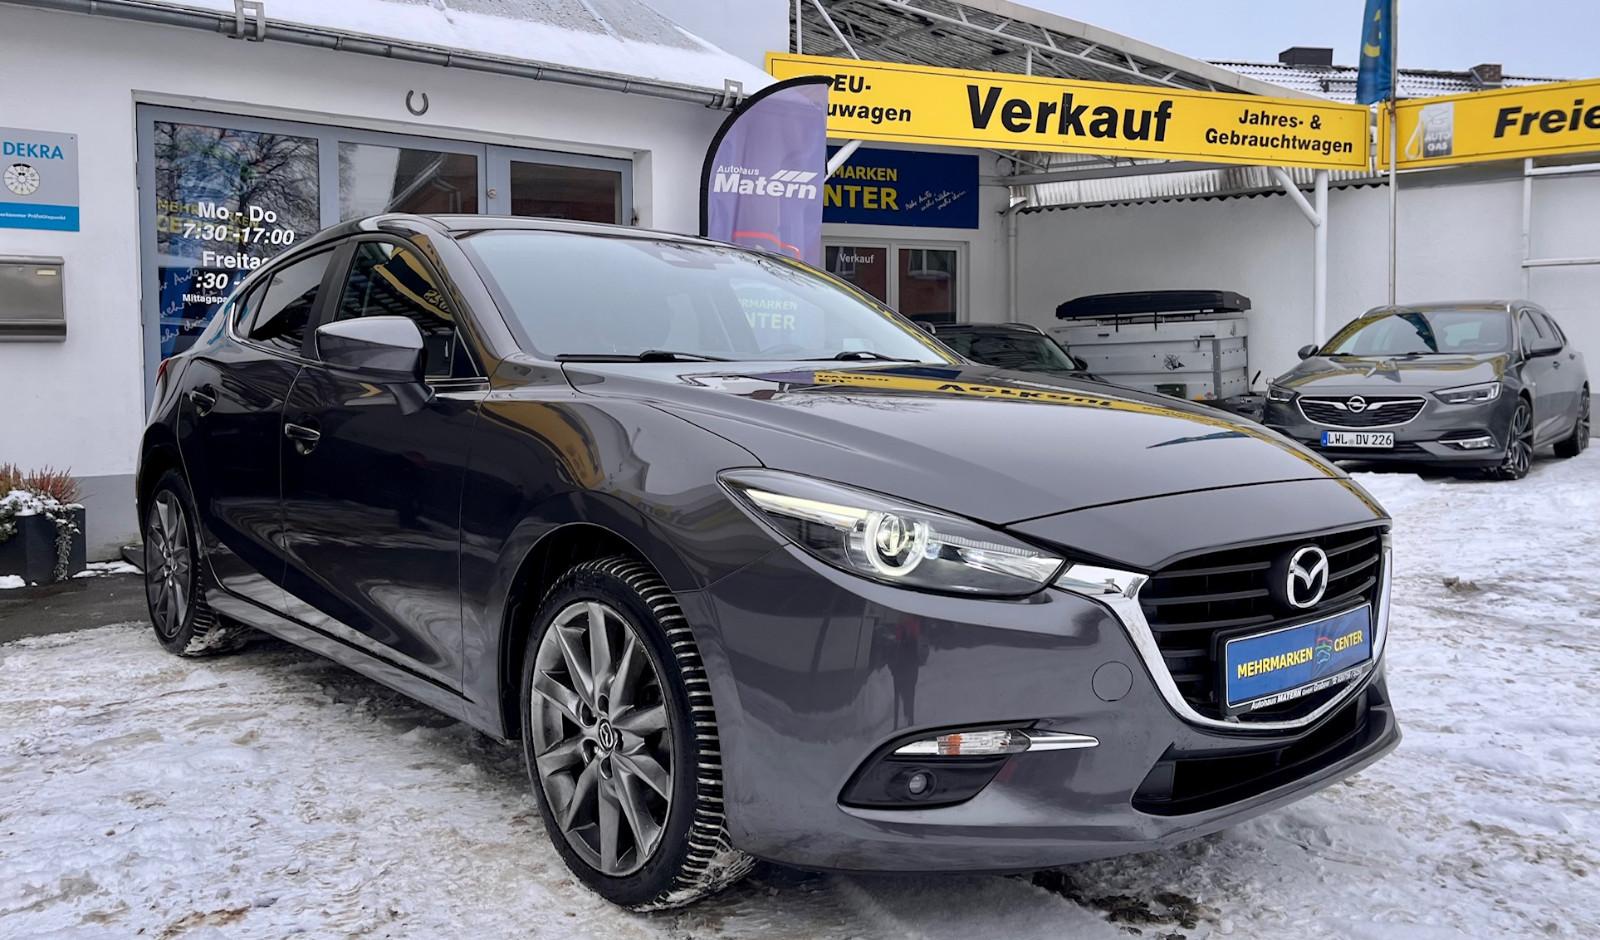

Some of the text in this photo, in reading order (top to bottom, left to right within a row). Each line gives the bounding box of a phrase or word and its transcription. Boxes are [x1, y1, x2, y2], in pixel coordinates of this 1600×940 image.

[834, 74, 871, 93] EU-
[966, 84, 1173, 143] Verkauf
[1238, 110, 1321, 129] Jahres- &
[3, 142, 64, 160] DEKRA
[1205, 128, 1353, 155] Gebrauchtwagen
[717, 165, 759, 176] Autohaus
[713, 173, 817, 200] Matern
[198, 201, 230, 220] Mo
[249, 205, 277, 223] Do
[183, 222, 227, 241] 7:30
[840, 253, 875, 264] Verkauf
[1328, 433, 1392, 446] LWL DV 226
[1237, 646, 1313, 679] MEHRMARKEN
[1334, 630, 1363, 652] CENTER
